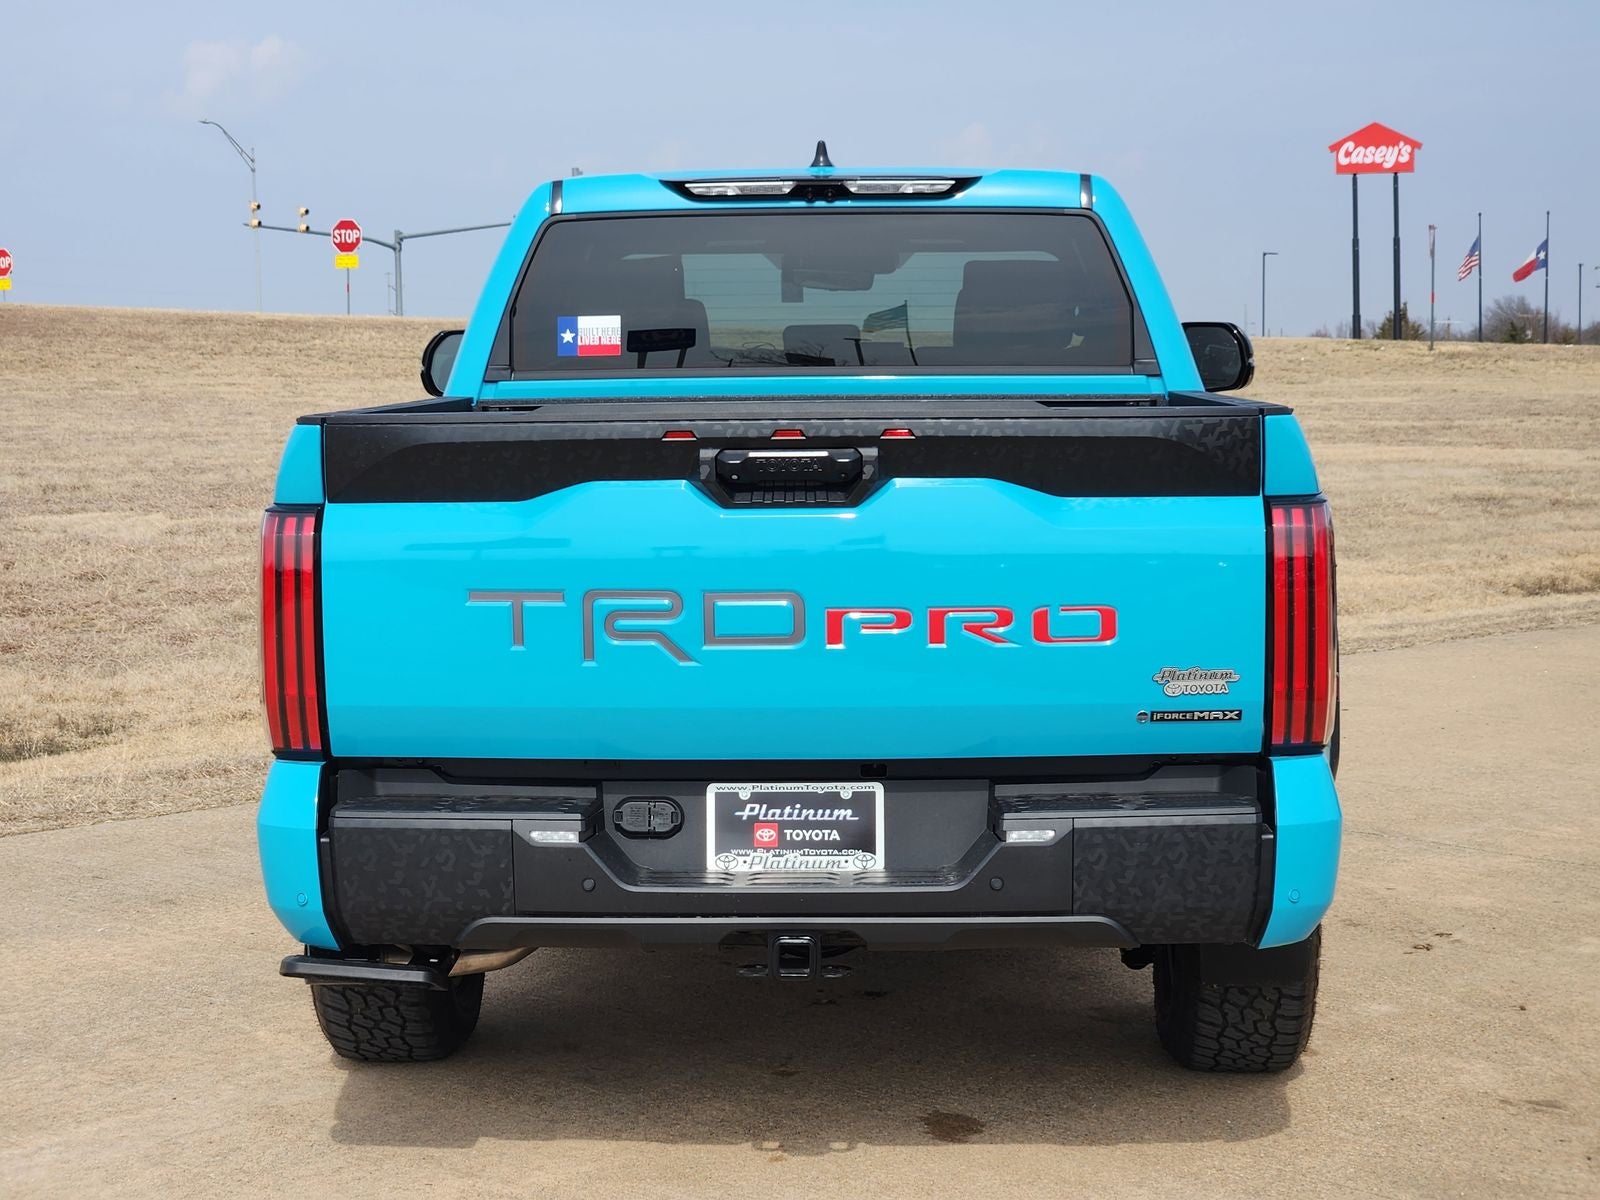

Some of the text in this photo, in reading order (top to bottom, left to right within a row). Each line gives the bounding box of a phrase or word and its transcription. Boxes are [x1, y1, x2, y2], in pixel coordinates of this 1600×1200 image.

[1338, 141, 1412, 168] Casey's
[333, 229, 360, 243] STOP
[0, 256, 11, 268] OP
[578, 327, 621, 337] BUILT HERE
[578, 336, 621, 345] LIVES HERE
[755, 458, 823, 472] TOYOTA
[466, 589, 1120, 666] TRD PRO
[1154, 667, 1239, 682] Platinum
[1184, 683, 1228, 693] TOYOTA
[716, 784, 875, 793] www.PlatinumToyota.com
[734, 803, 859, 820] Platinum
[784, 829, 841, 841] TOYOTA
[749, 853, 848, 870] Platinum
